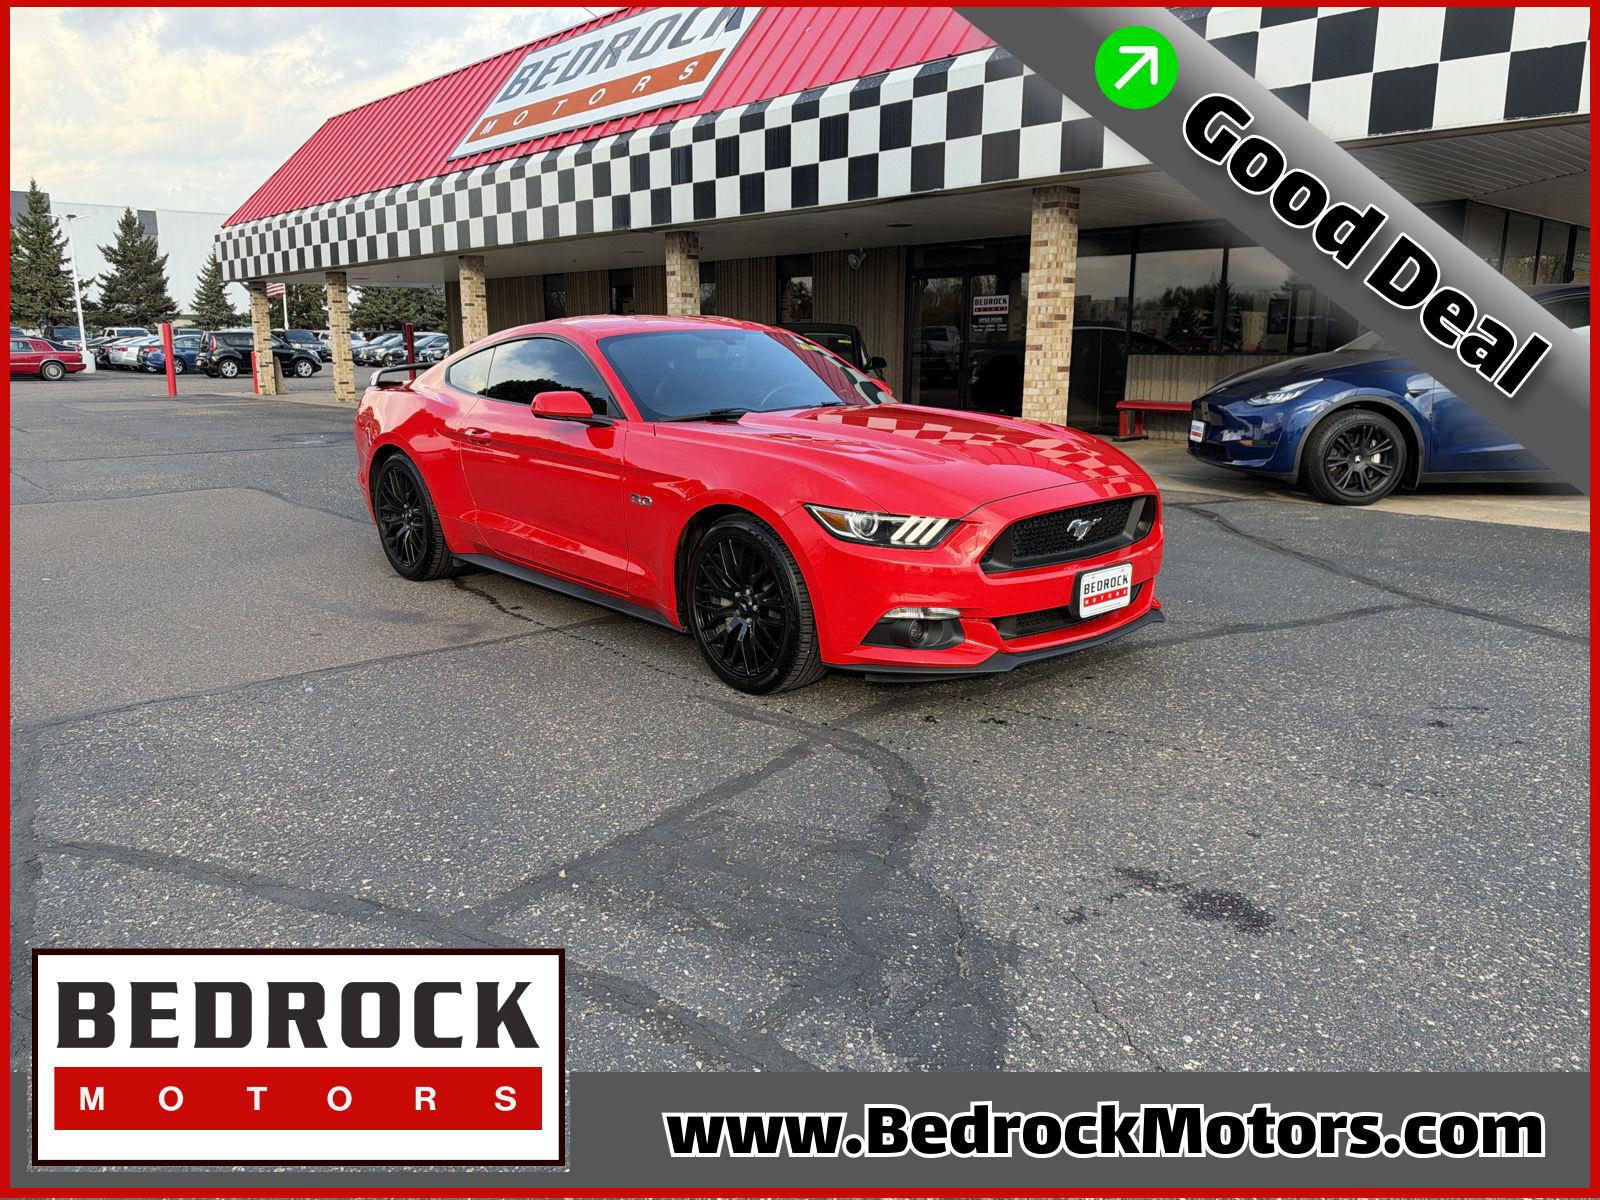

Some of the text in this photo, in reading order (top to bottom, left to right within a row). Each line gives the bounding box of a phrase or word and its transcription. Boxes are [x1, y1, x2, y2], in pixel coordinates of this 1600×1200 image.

[498, 7, 746, 104] BEDROCK
[479, 60, 700, 137] MOTORS
[974, 297, 1008, 306] BEDROCK
[1084, 574, 1128, 595] BEDROCK
